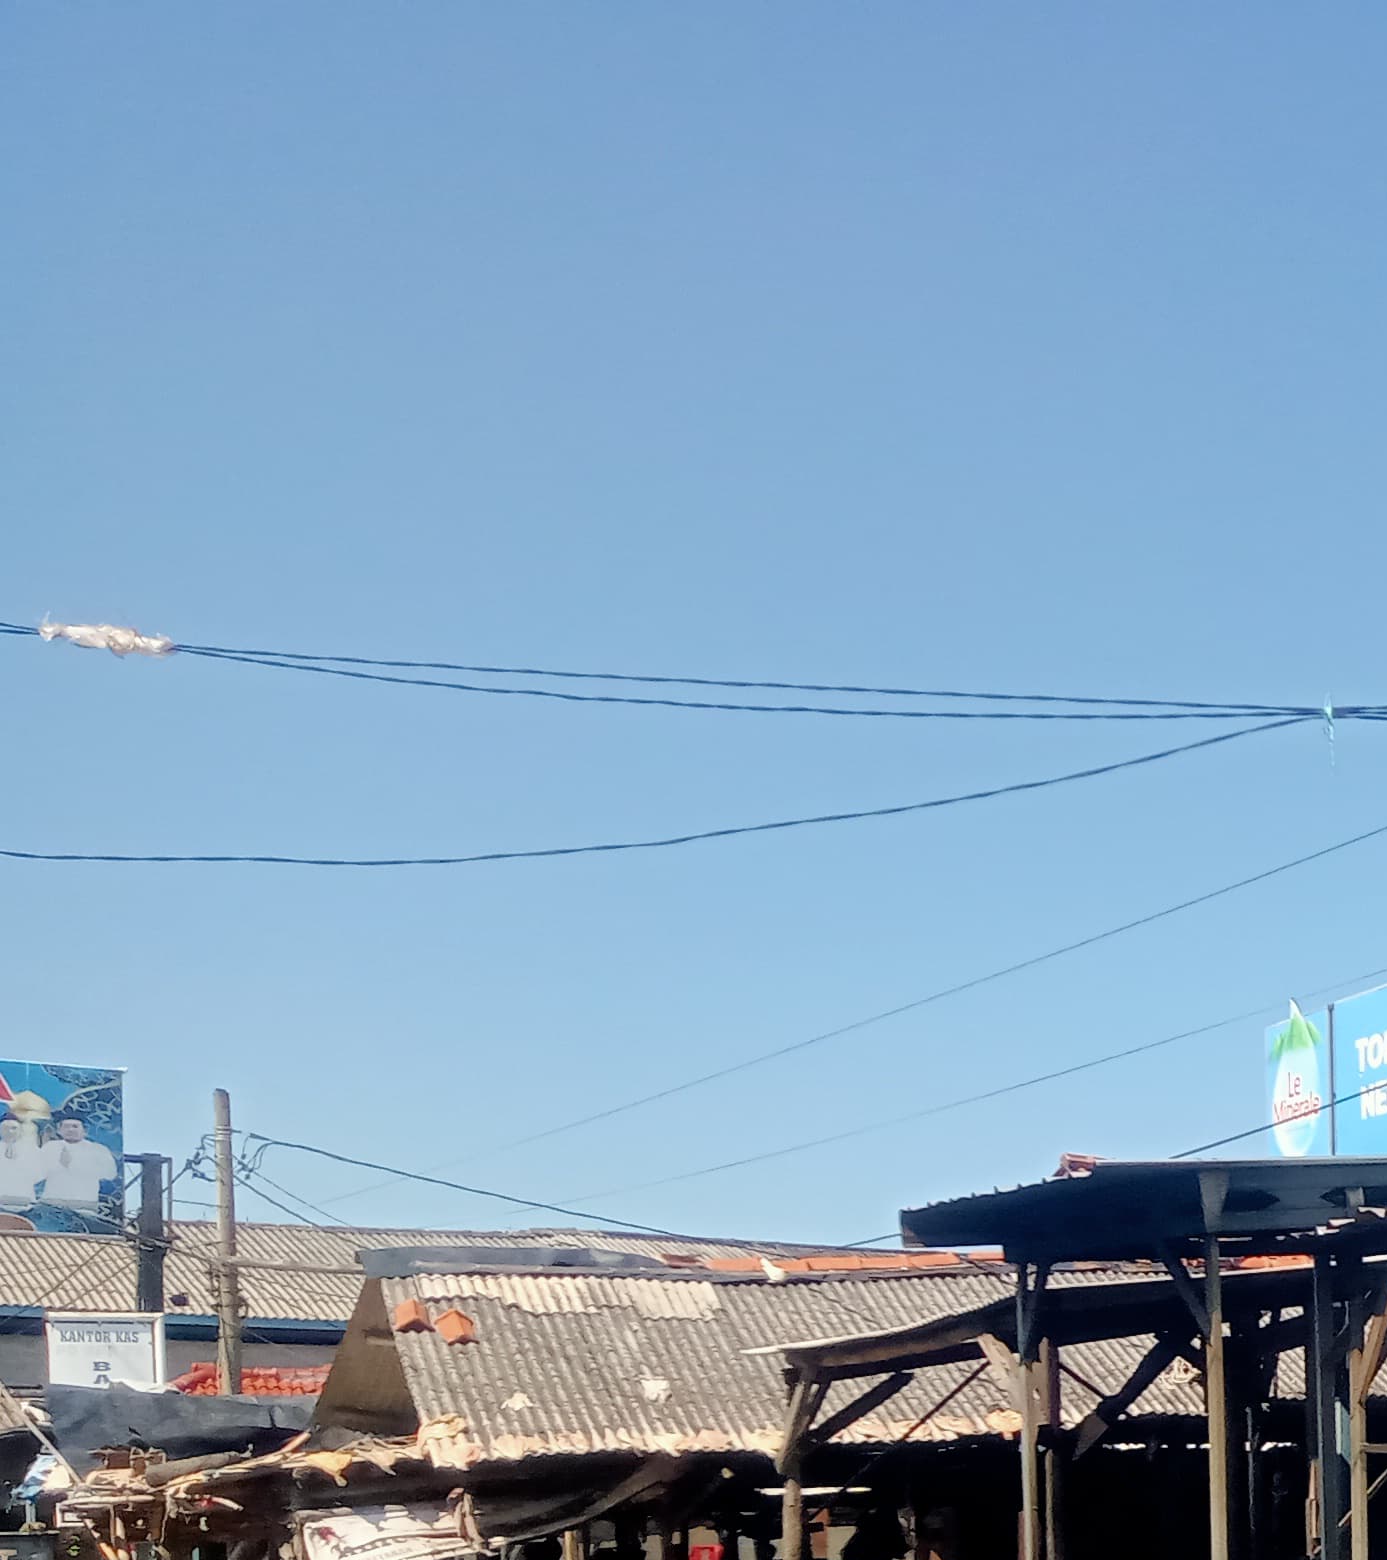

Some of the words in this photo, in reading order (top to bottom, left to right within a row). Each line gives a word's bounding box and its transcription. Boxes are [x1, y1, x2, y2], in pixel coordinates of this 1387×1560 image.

[1287, 1071, 1301, 1098] Le
[60, 1330, 111, 1343] KANTOR
[116, 1331, 139, 1343] KAS
